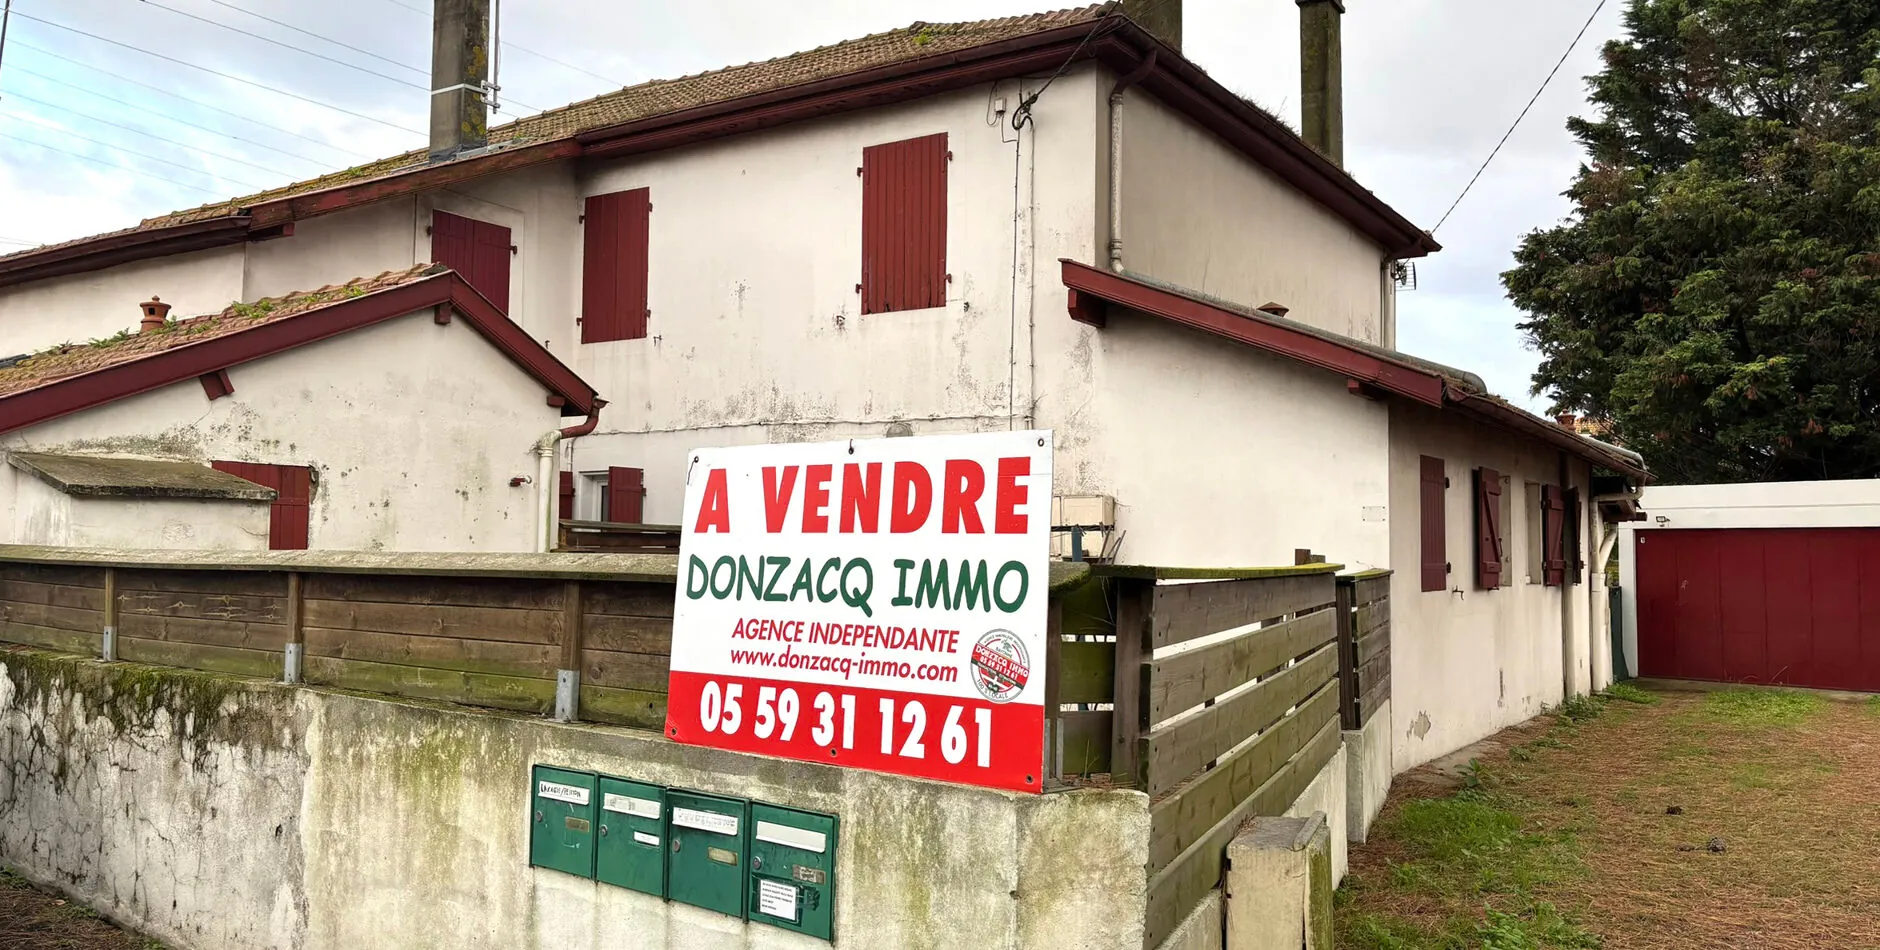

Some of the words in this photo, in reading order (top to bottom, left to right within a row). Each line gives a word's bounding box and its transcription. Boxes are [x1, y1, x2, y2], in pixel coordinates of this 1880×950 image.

[695, 469, 730, 533] A
[762, 457, 1030, 534] VENDRE
[687, 554, 872, 617] DONZACQ
[891, 560, 1028, 613] IMMO
[731, 646, 958, 683] www.donzacq-immo.com
[732, 619, 804, 642] AGENCE
[809, 623, 959, 654] INDEPENDANTE
[701, 681, 742, 734] 05
[755, 686, 800, 741] 59
[812, 691, 856, 749] 31
[880, 698, 927, 758] 12
[941, 705, 991, 767] 61
